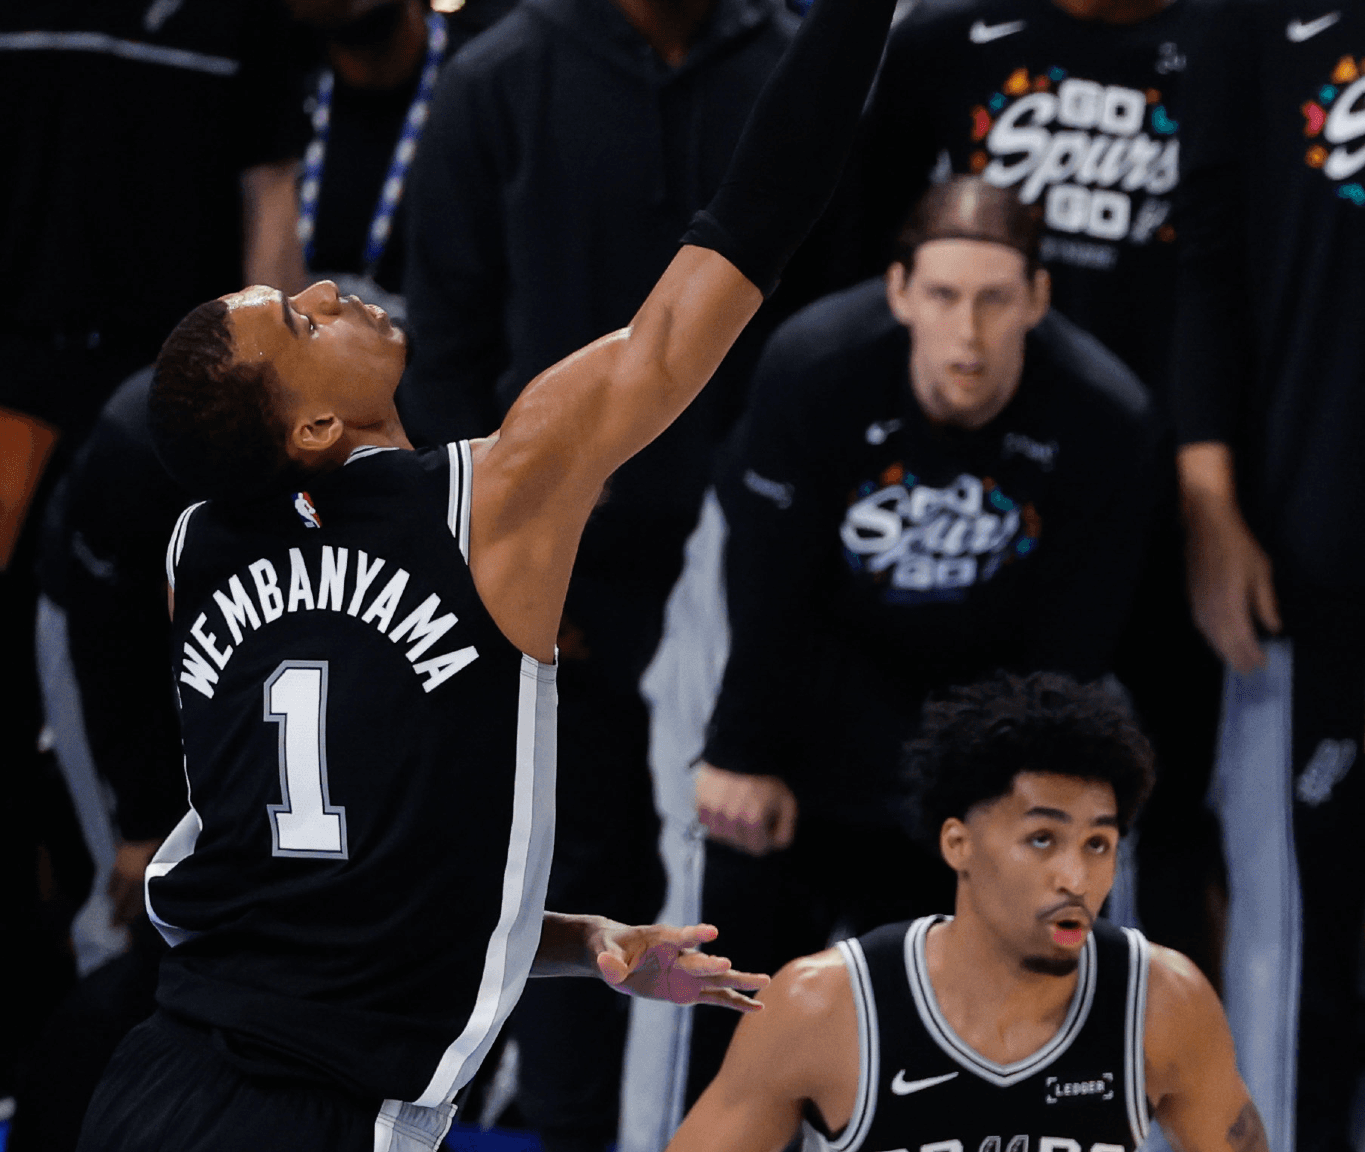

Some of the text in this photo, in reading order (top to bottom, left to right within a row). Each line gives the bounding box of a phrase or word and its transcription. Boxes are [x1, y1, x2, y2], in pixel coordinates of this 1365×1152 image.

[985, 92, 1180, 205] Spurs
[1058, 77, 1146, 136] GO
[1045, 183, 1131, 241] GO
[180, 545, 480, 702] WEMBANYAMA
[263, 659, 349, 860] 1
[1055, 1080, 1105, 1098] LEDGER
